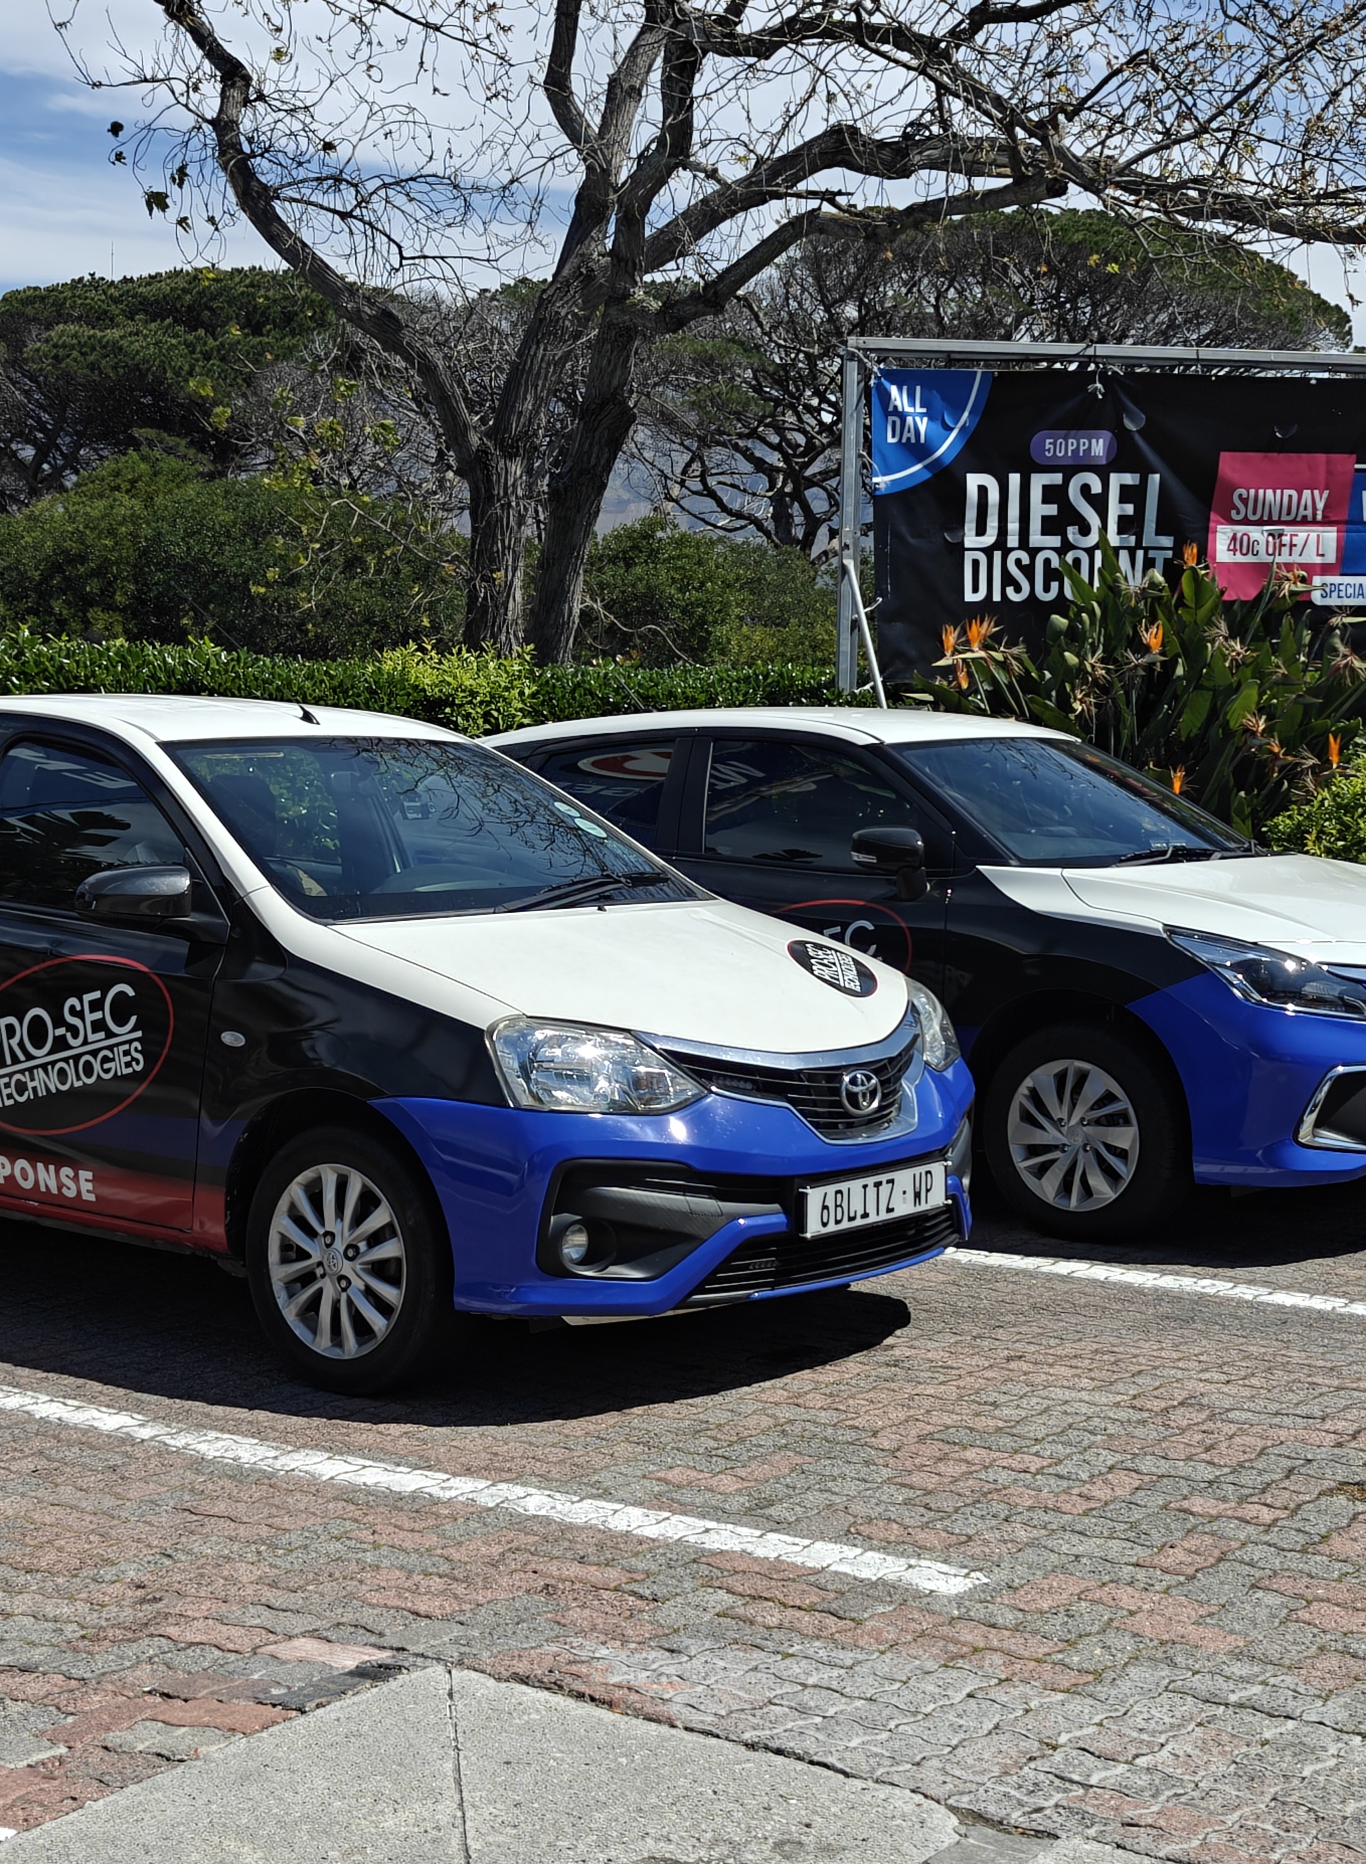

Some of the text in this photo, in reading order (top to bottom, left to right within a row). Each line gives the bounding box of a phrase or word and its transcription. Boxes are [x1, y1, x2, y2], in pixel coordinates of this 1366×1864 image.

[888, 385, 927, 412] ALL
[887, 416, 928, 443] DAY
[1045, 438, 1104, 457] 50PPM
[964, 472, 1174, 548] DIESEL
[1231, 488, 1330, 522] SUNDAY
[1227, 532, 1260, 557] 40c
[1316, 533, 1325, 558] L
[820, 1169, 934, 1228] 6BLITZ WP
